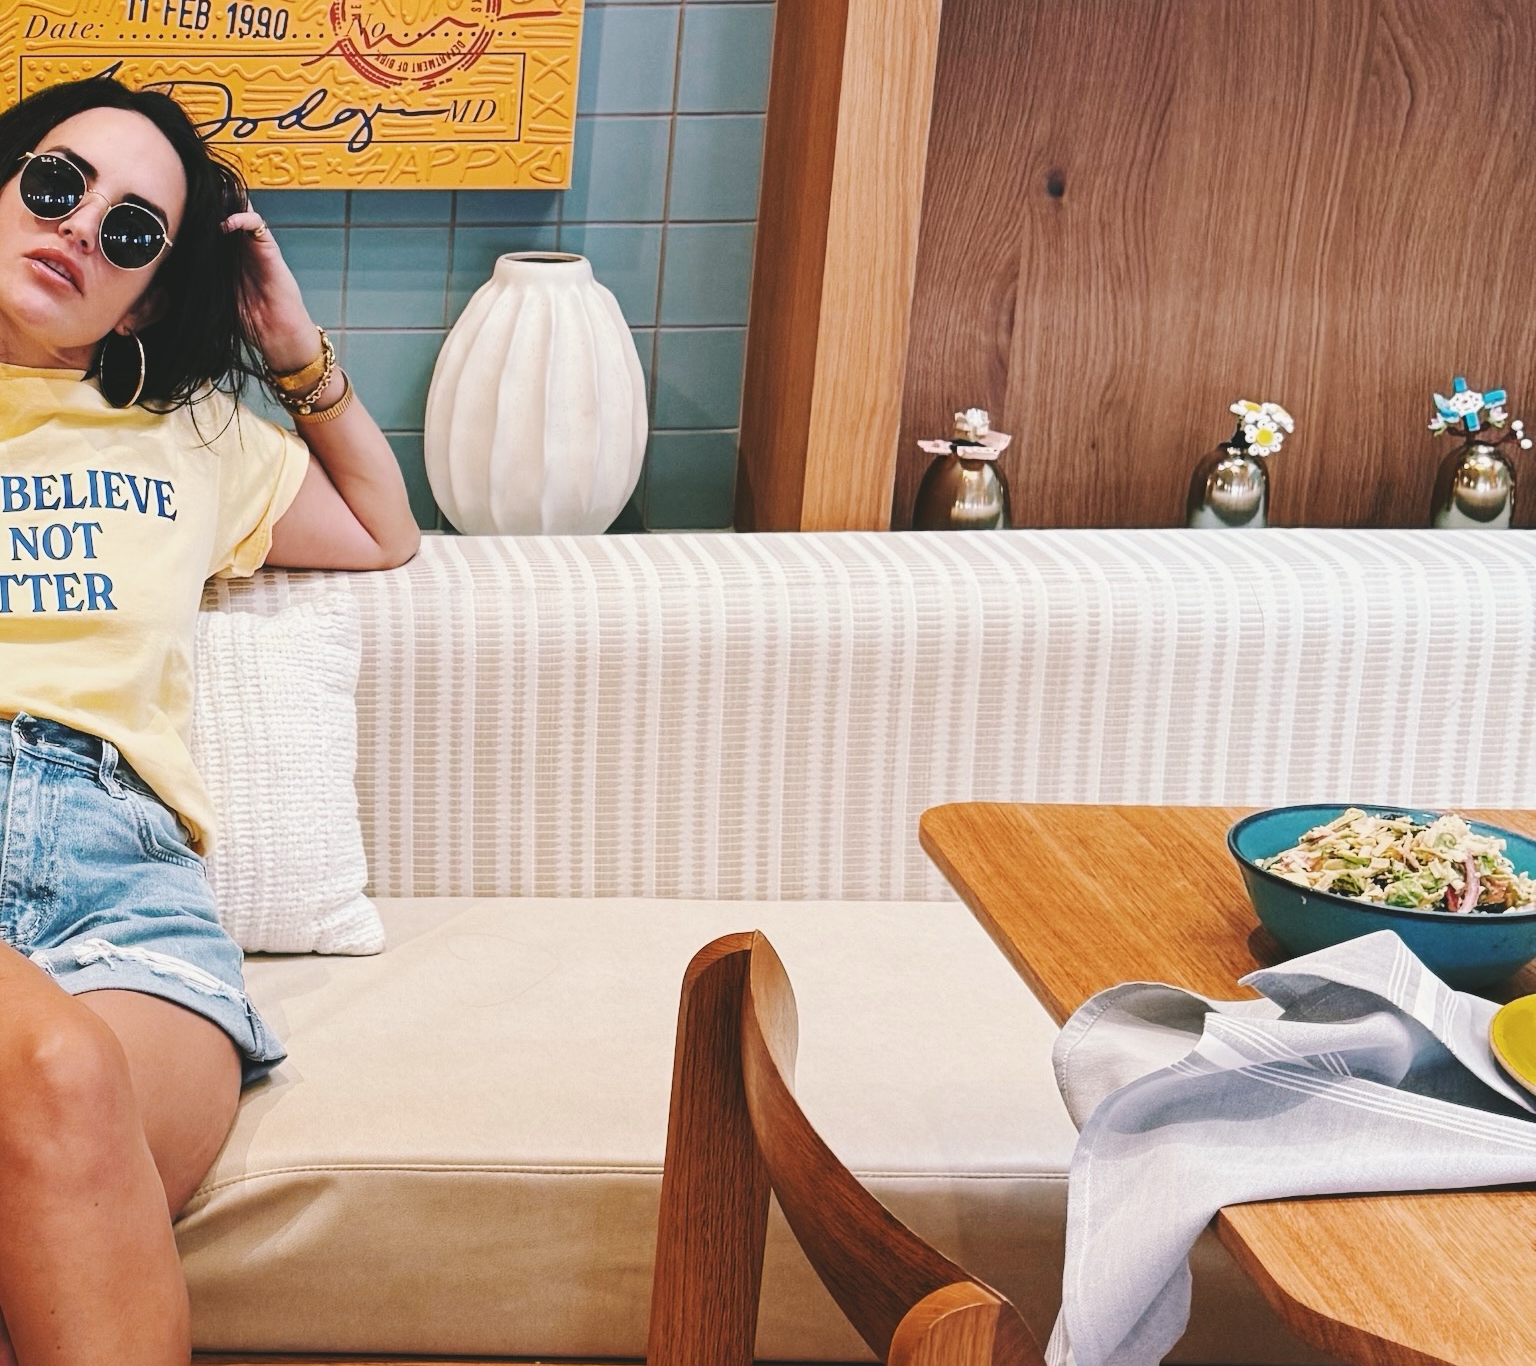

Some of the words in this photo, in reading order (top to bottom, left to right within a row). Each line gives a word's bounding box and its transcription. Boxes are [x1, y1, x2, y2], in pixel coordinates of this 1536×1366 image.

[22, 13, 105, 41] Date:
[226, 1, 289, 42] 1990
[443, 98, 497, 124] MD
[0, 468, 179, 523] BELIEVE
[10, 520, 104, 562] NOT
